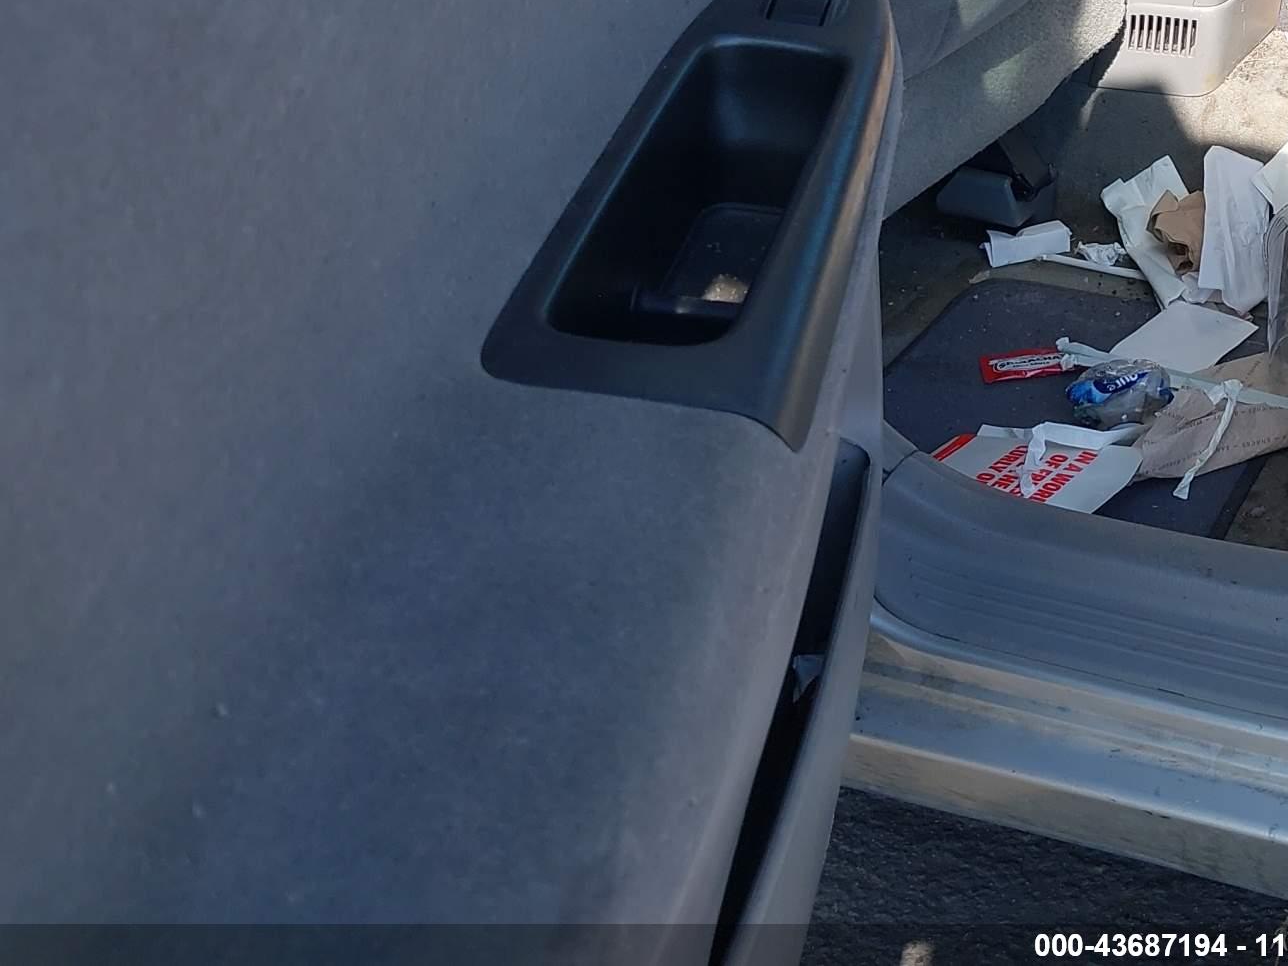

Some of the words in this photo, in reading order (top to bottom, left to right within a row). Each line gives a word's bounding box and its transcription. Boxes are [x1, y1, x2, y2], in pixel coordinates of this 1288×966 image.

[1045, 454, 1069, 469] OF
[1074, 450, 1099, 465] IN
[1063, 463, 1083, 472] A
